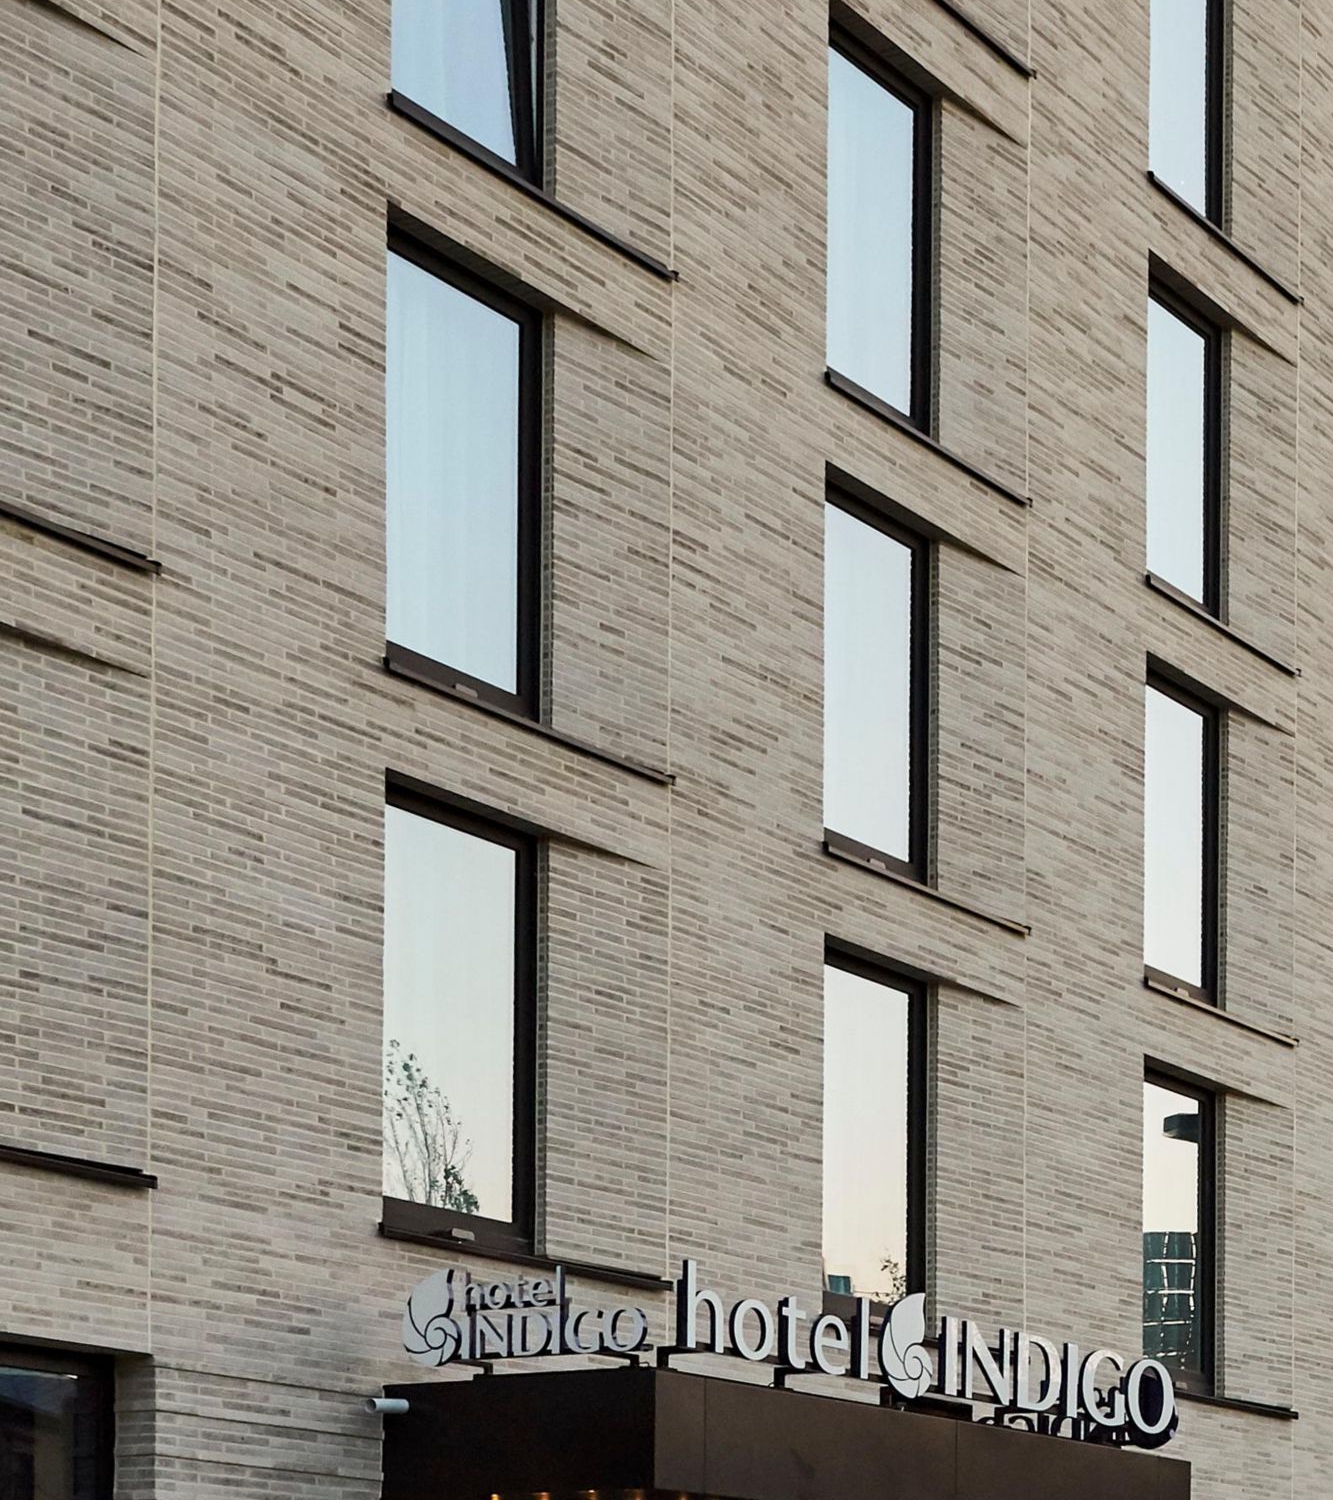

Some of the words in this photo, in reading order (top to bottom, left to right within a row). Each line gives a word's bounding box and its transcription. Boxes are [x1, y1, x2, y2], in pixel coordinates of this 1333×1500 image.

[462, 1265, 566, 1311] hotel
[460, 1307, 648, 1359] INDIGO
[679, 1259, 870, 1380] hotel
[940, 1315, 1176, 1435] INDIGO
